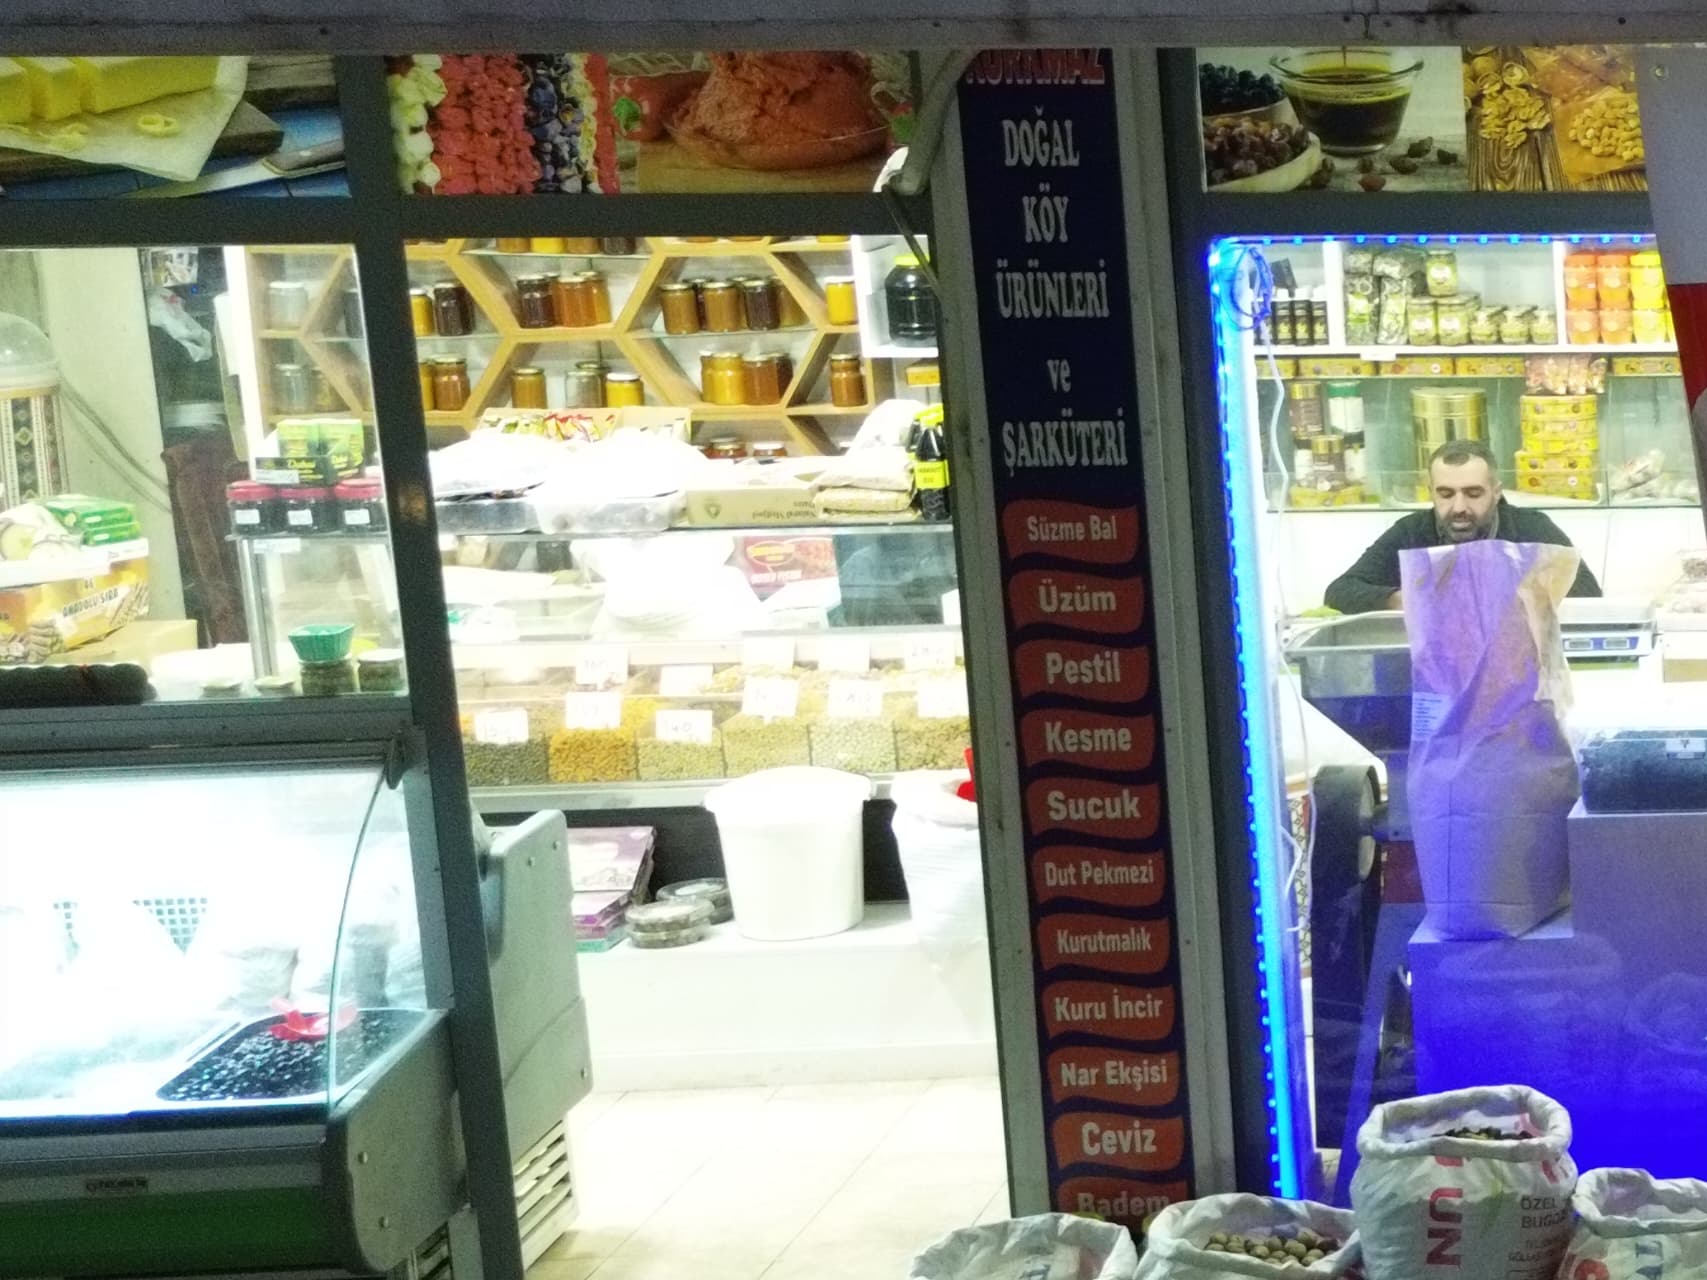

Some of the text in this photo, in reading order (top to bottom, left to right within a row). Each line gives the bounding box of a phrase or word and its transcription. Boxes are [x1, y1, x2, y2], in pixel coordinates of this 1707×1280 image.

[1001, 106, 1080, 168] DOĞAL
[1022, 183, 1069, 243] KÖY
[996, 260, 1109, 319] ÜRÜNLERİ
[1047, 359, 1072, 394] ve
[1002, 408, 1129, 476] ŞARKÜTERİ
[1028, 514, 1118, 543] Süzme Bal
[1038, 577, 1117, 613] Üzüm
[1046, 649, 1121, 685] Pestil
[1044, 721, 1132, 754] Kesme
[1047, 789, 1141, 822] Sucuk
[1044, 860, 1155, 887] Dut Pekmezi
[1057, 928, 1152, 954] Kurutmalık
[1054, 988, 1163, 1021] Kuru İncir
[1061, 1058, 1168, 1090] Nar Ekşisi
[1081, 1121, 1158, 1155] Ceviz
[1077, 1190, 1170, 1217] Badem
